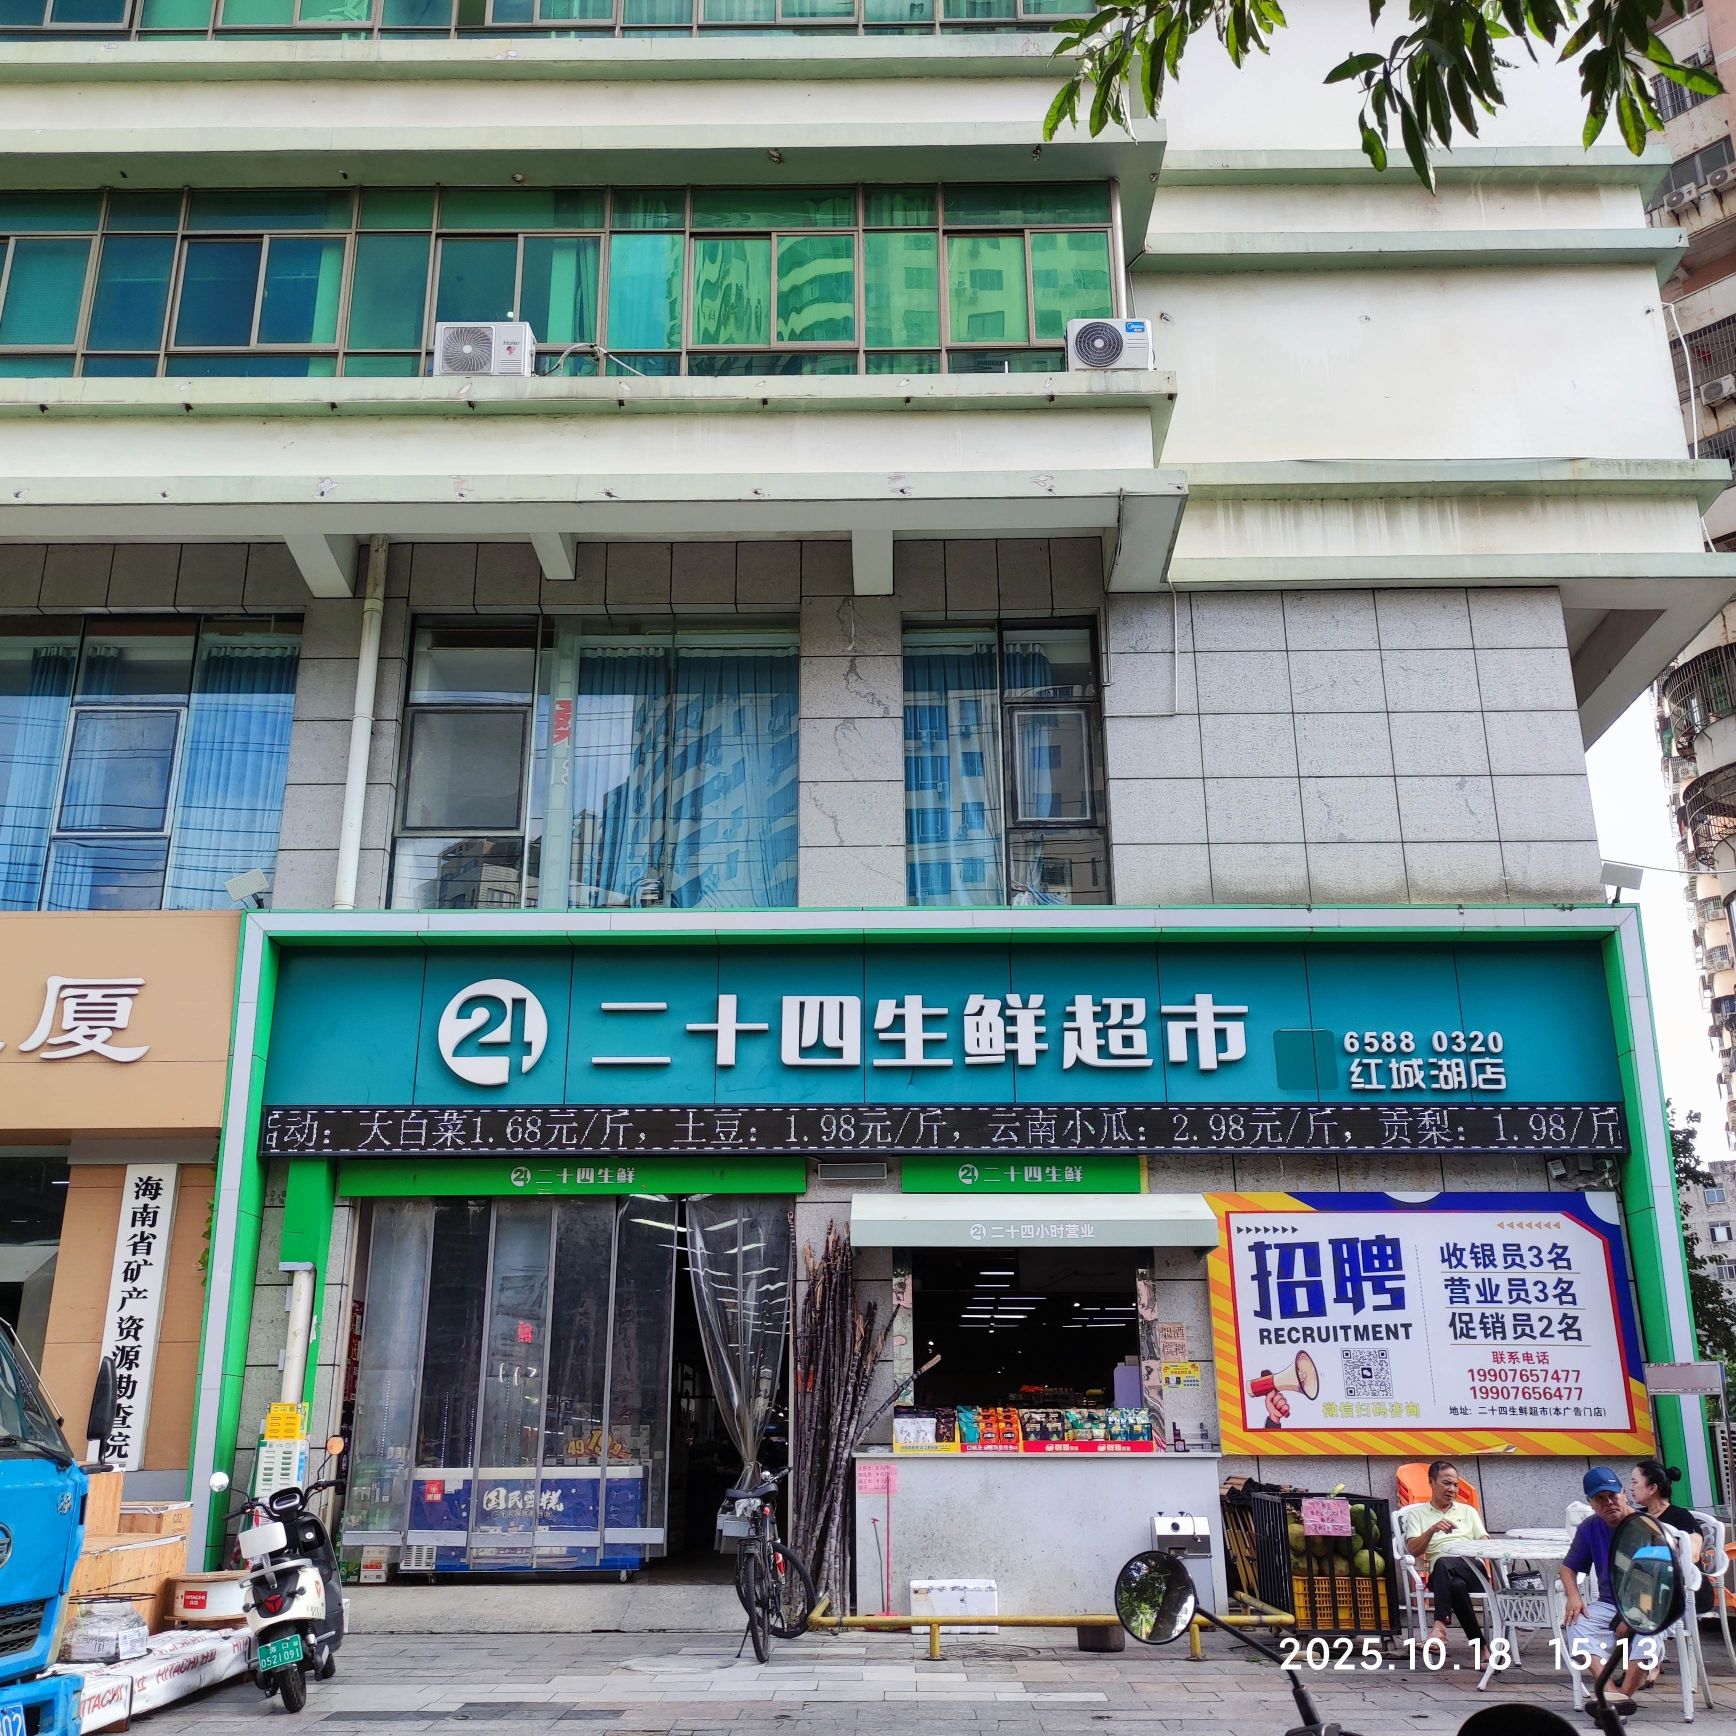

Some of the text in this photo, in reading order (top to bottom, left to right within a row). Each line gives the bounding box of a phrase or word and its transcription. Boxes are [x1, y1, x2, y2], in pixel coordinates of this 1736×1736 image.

[0, 975, 151, 1062] 厦
[590, 993, 1248, 1070] 二十四生鲜超市
[1343, 1030, 1504, 1053] 6588 0320
[1349, 1057, 1507, 1090] 红城湖店
[535, 1165, 636, 1186] 二十四生鲜
[983, 1165, 1084, 1183] 二十四生鲜
[990, 1222, 1095, 1240] 二十四小时营业
[1439, 1241, 1574, 1271] 收银员3名
[1248, 1234, 1407, 1320] 招聘
[1444, 1276, 1578, 1306] 营业员3名
[1258, 1321, 1413, 1345] RECRUITMENT
[1448, 1311, 1584, 1342] 促销员2名
[1491, 1350, 1550, 1366] 联系电话
[1467, 1368, 1581, 1384] 19907657477
[1469, 1385, 1584, 1402] 19907656477
[1322, 1400, 1421, 1419] 微信扫码咨询
